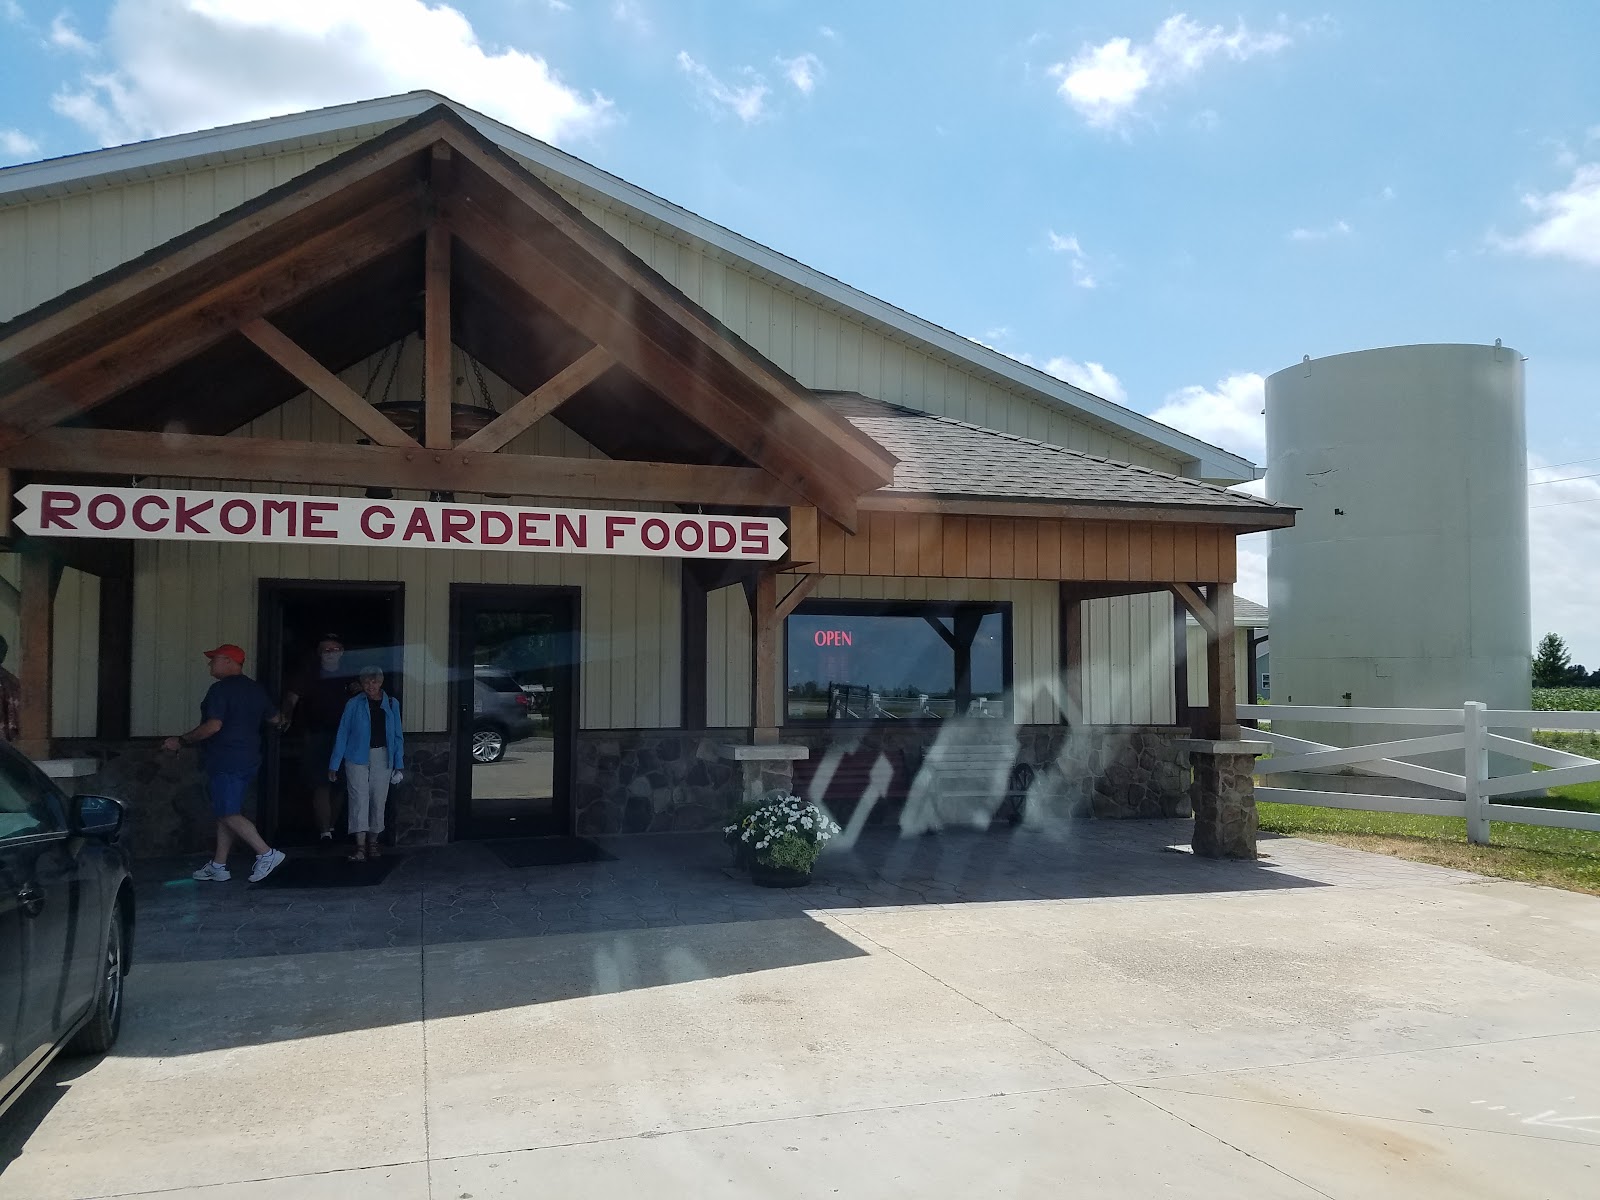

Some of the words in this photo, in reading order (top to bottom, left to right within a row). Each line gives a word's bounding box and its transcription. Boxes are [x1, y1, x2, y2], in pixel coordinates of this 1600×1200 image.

[40, 491, 339, 538] ROCKOME
[360, 505, 587, 548] GARDEN
[605, 516, 769, 554] FOODS
[814, 630, 852, 646] OPEN
